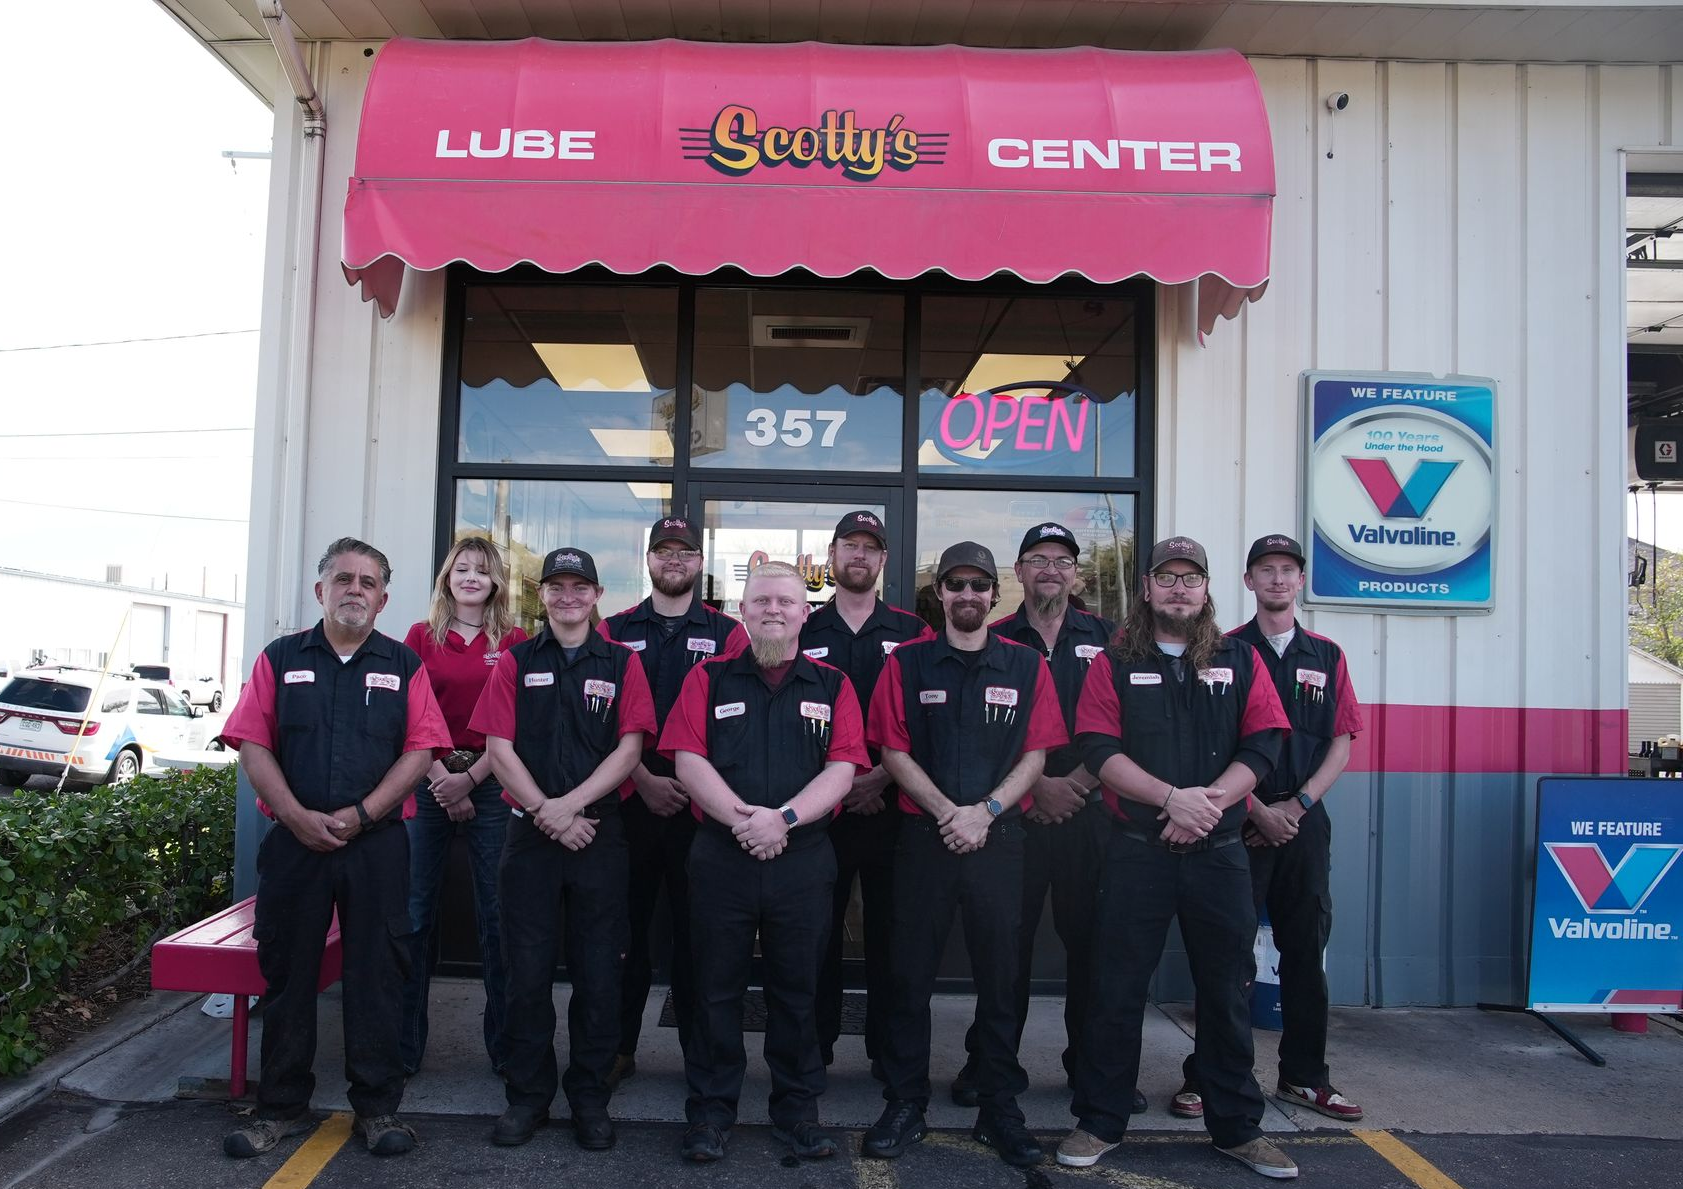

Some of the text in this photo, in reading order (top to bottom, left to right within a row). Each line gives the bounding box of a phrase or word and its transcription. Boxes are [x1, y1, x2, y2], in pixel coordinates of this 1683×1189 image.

[435, 104, 1242, 182] LUBE Scotty's CENTER
[1351, 387, 1457, 401] WE FEATURE
[744, 408, 847, 447] 357
[940, 393, 1090, 452] OPEN
[1366, 430, 1440, 442] 100 Years
[1364, 442, 1443, 453] Under the Hood
[1348, 524, 1456, 546] Valvoline
[1359, 581, 1450, 594] PRODUCTS
[719, 705, 740, 714] George
[1571, 821, 1662, 836] WE FEATURE
[1548, 918, 1671, 940] Valvoline
